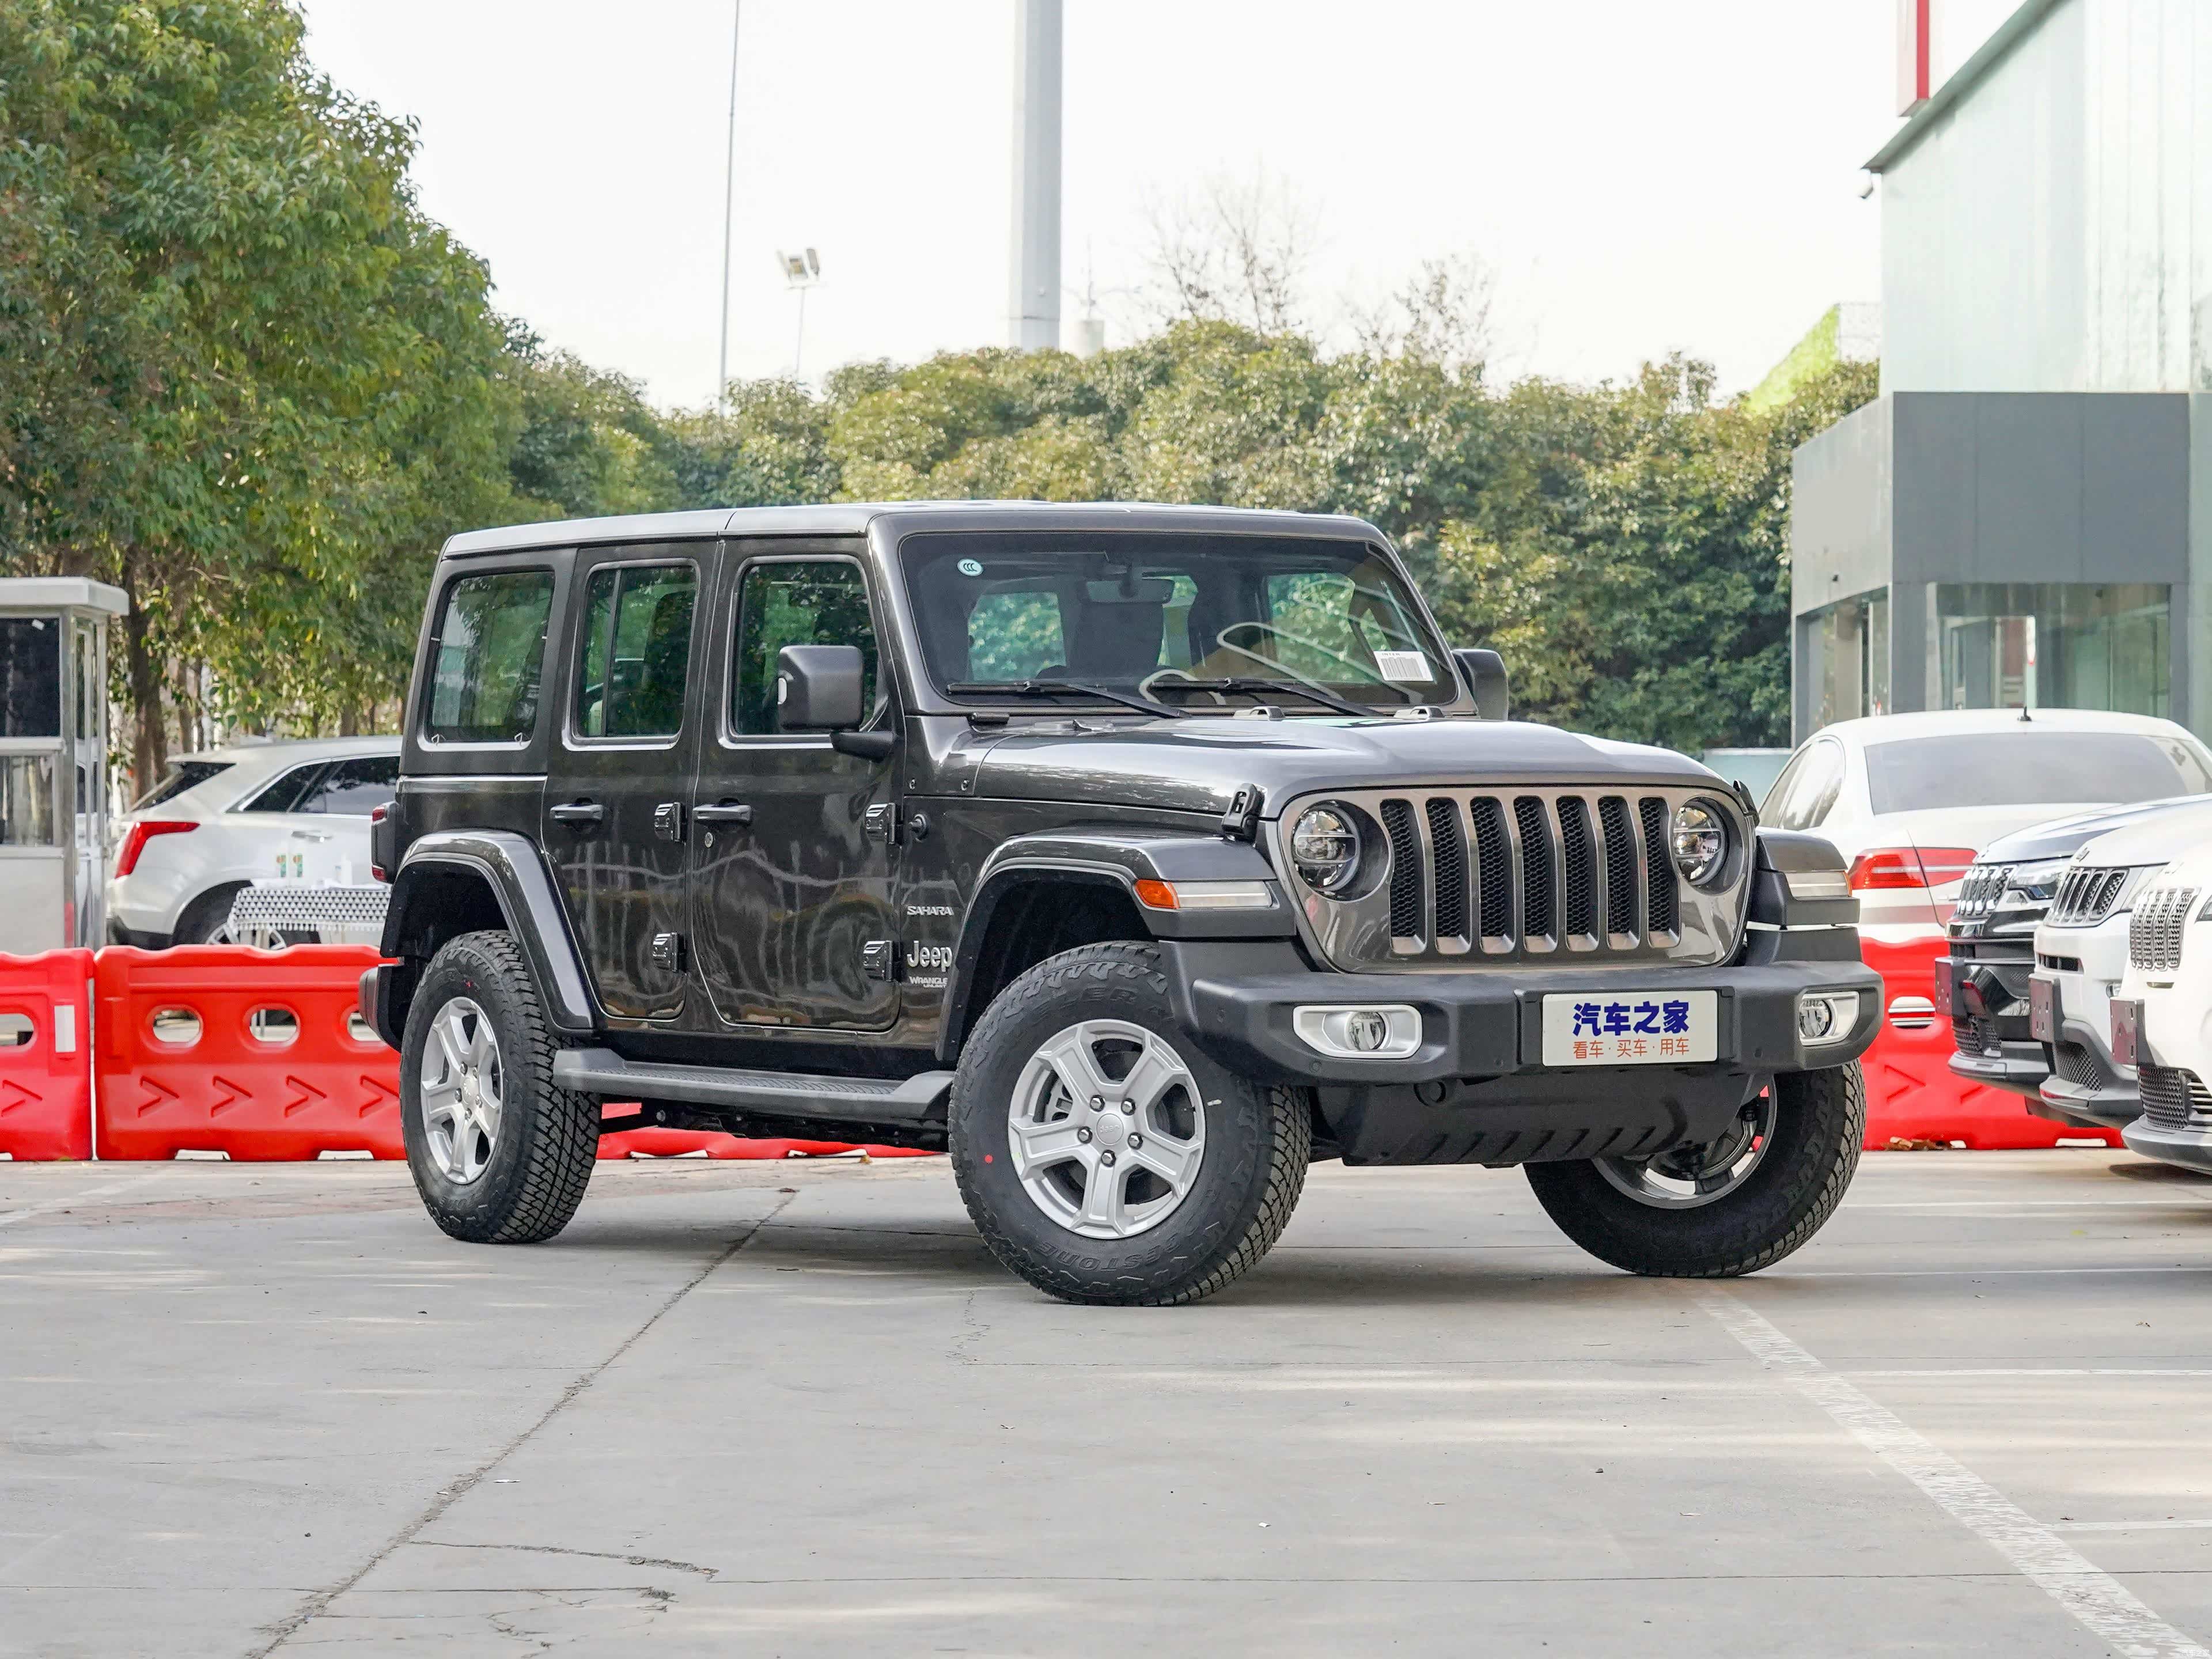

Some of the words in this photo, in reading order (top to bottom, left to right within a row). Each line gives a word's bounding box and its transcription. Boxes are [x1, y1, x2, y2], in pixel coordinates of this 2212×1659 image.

[907, 906, 954, 915] SAHARA
[907, 940, 953, 972] Jeep
[909, 976, 948, 984] WRANGLE
[1573, 1000, 1690, 1036] 汽车之家
